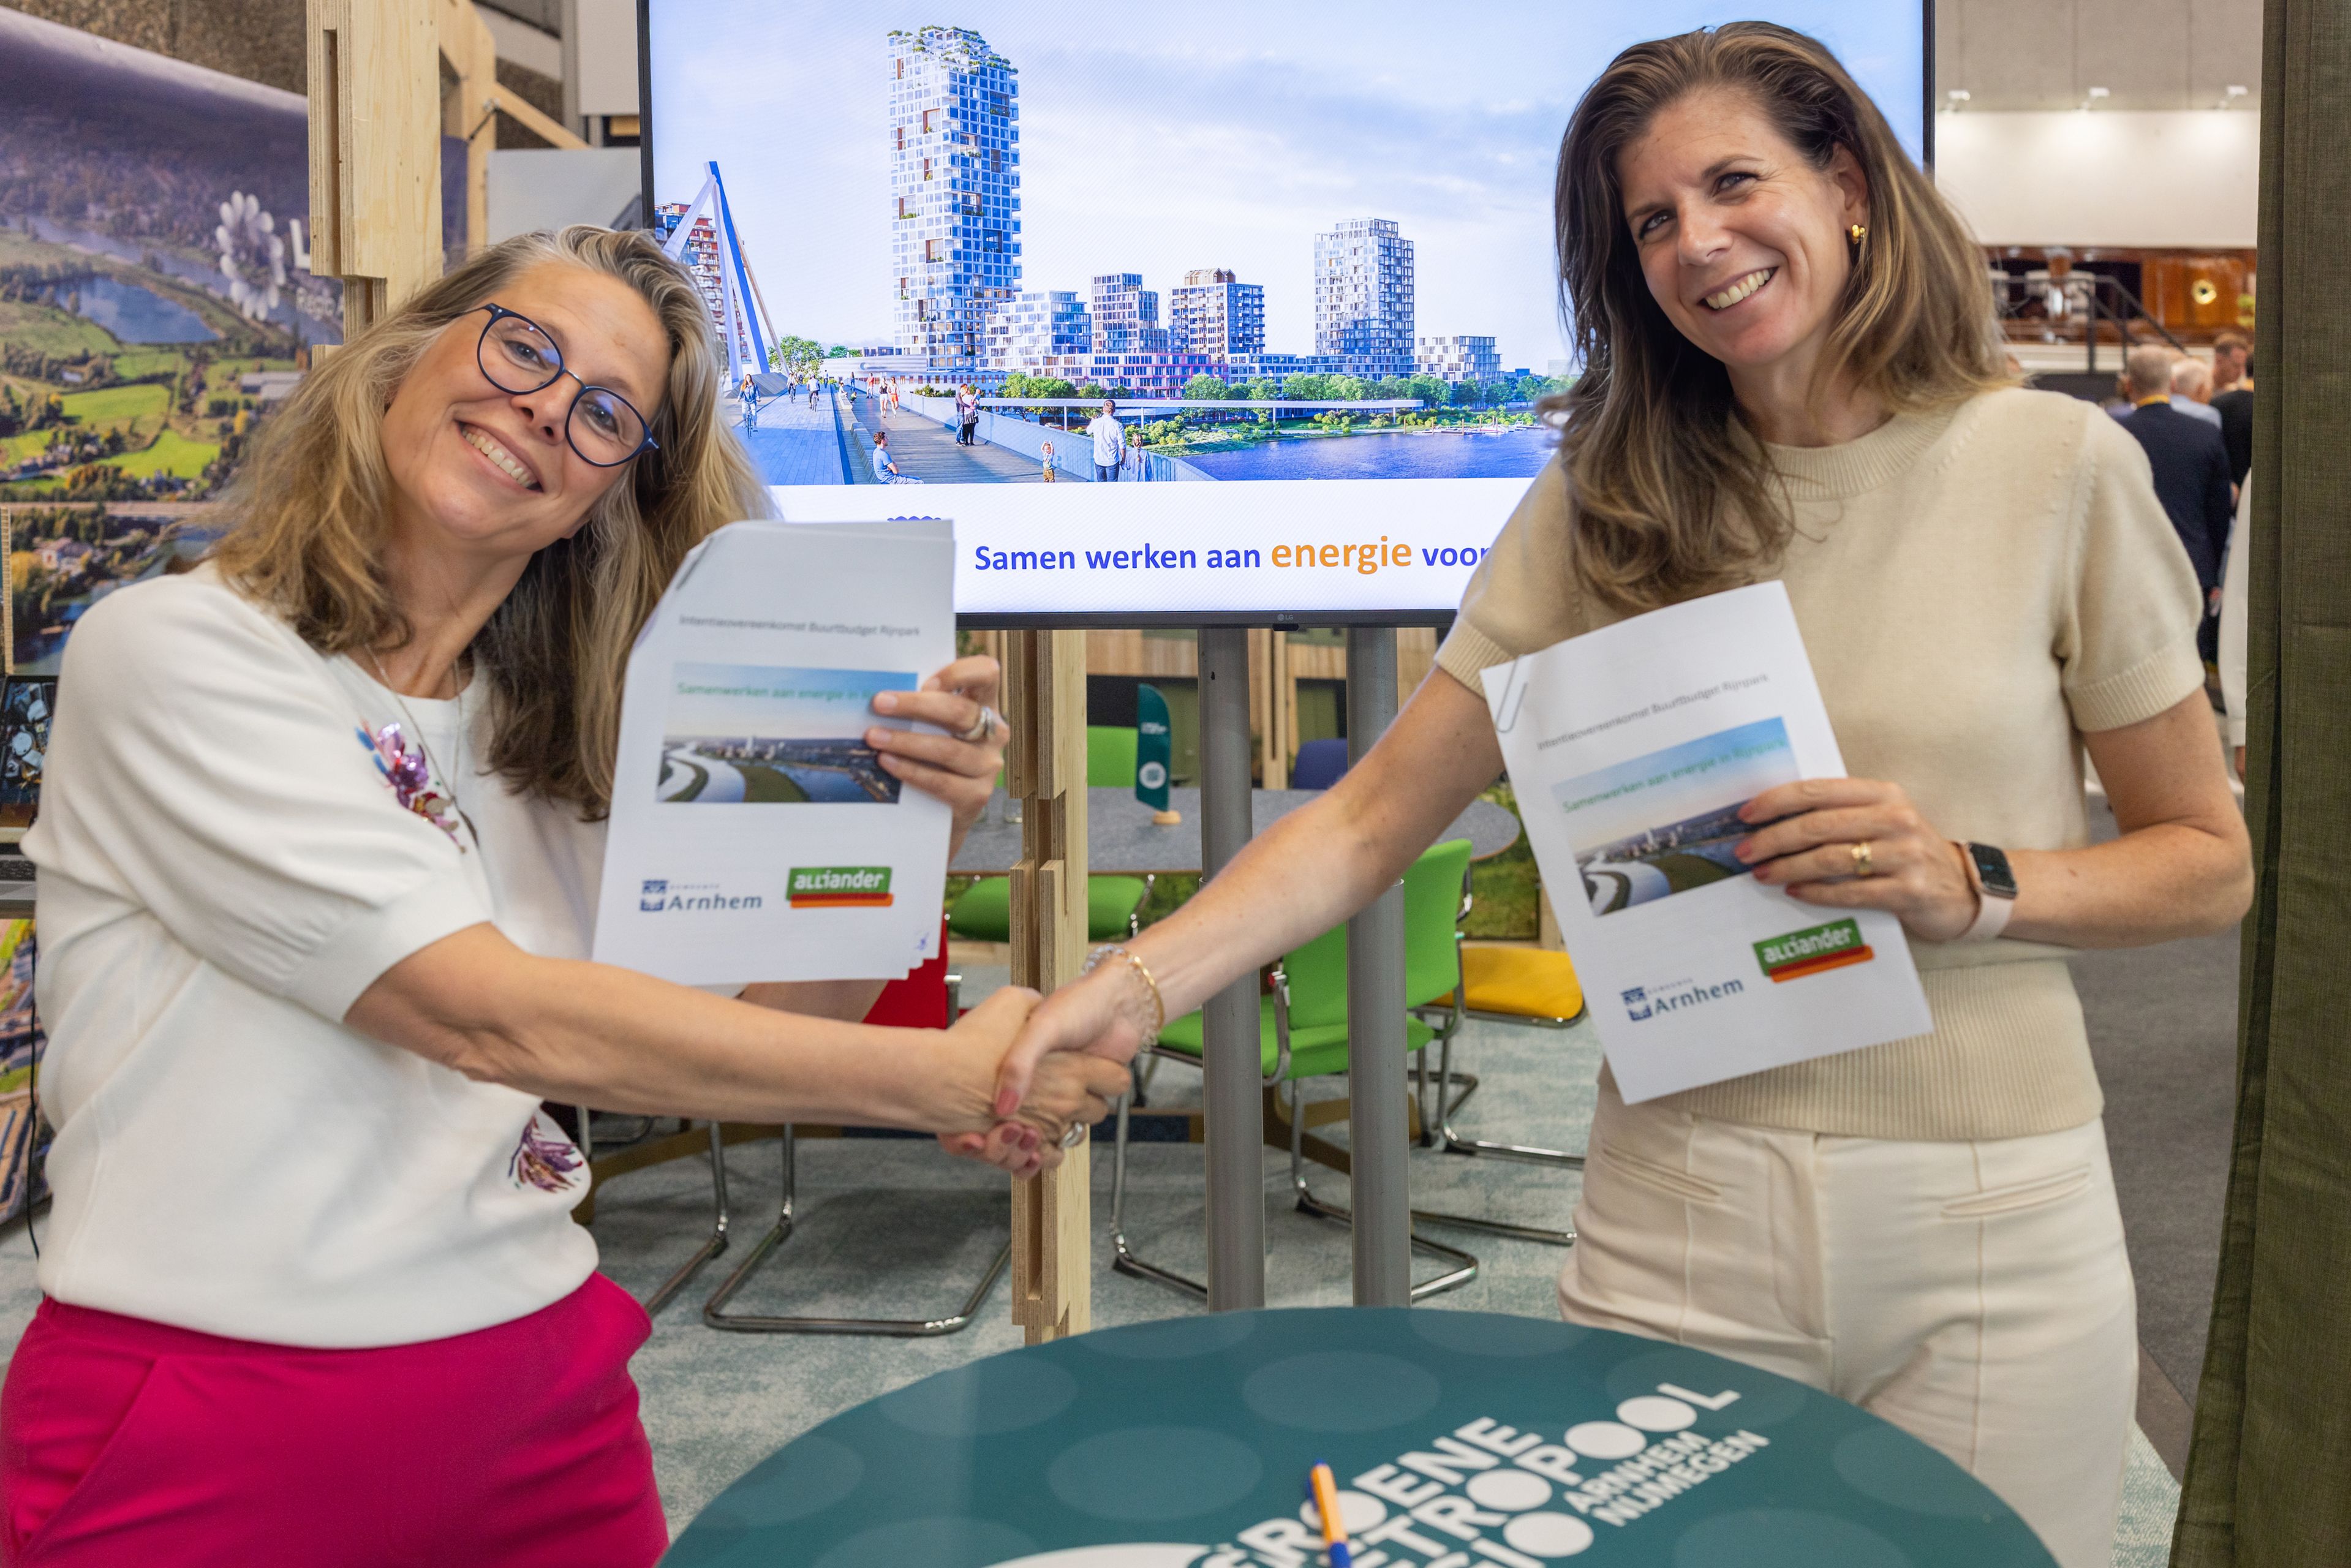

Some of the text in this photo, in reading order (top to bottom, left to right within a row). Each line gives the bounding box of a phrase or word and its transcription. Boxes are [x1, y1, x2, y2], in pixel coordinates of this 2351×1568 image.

[975, 545, 1076, 570] Samen
[1085, 543, 1197, 570] werken
[1206, 546, 1261, 568] aan
[1270, 535, 1412, 575] energie
[793, 869, 884, 890] alliander
[668, 894, 763, 911] Arnhem
[1762, 925, 1852, 964] alliander
[1654, 979, 1745, 1014] Arnhem
[1563, 1430, 1711, 1513] ARNHEM
[1591, 1428, 1770, 1527] NIJMEGEN
